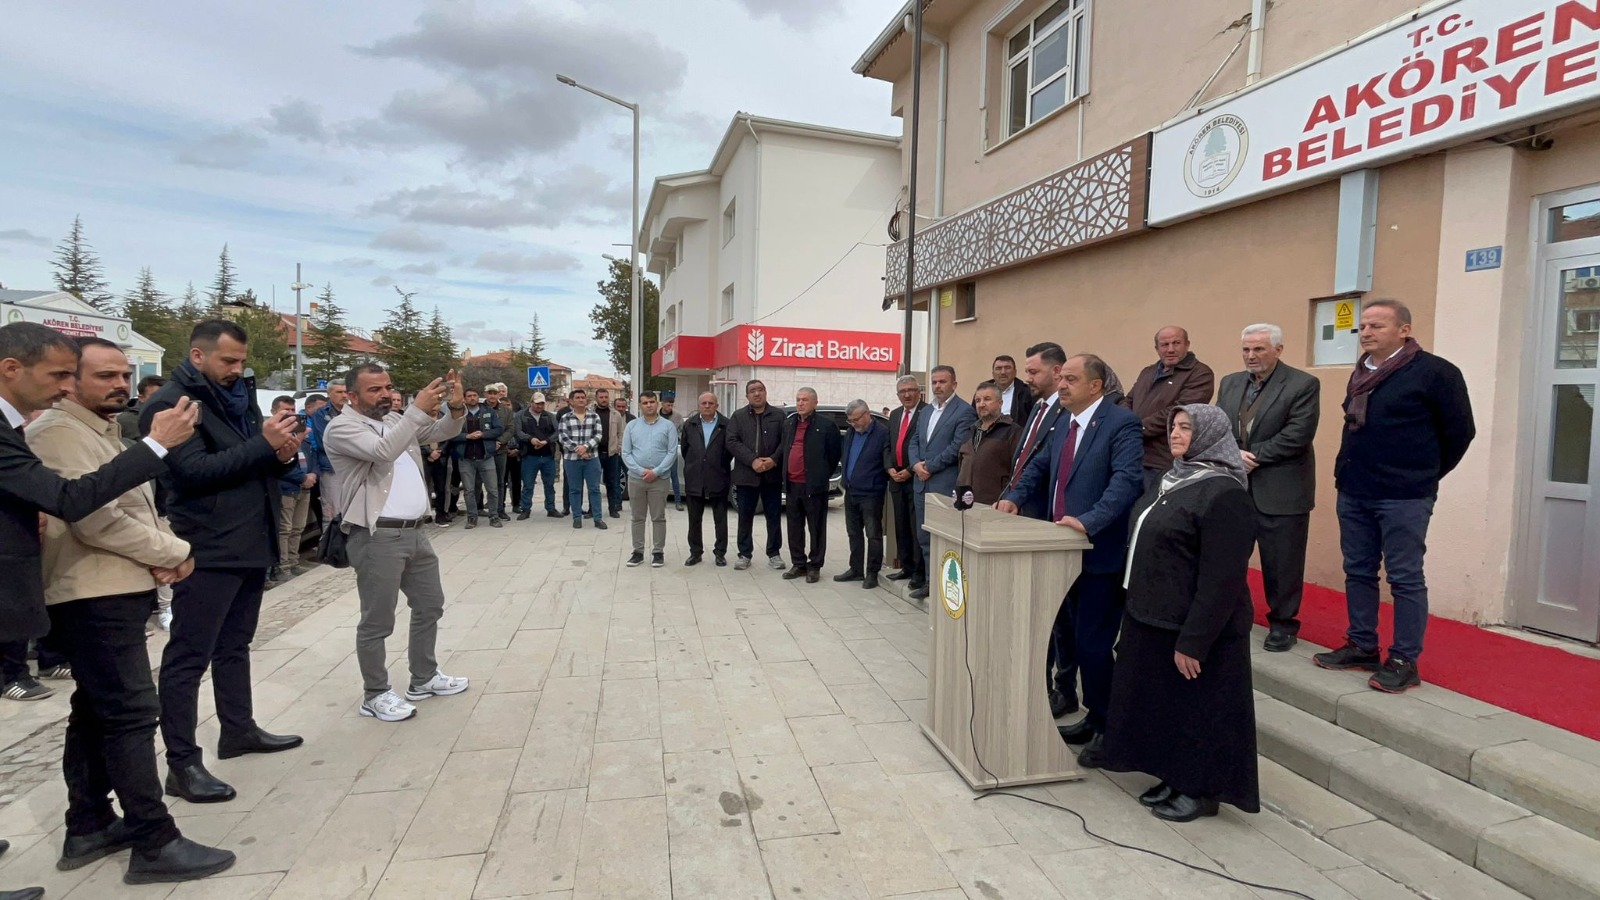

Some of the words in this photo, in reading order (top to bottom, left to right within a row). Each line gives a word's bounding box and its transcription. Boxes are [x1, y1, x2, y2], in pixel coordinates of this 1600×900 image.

[1406, 13, 1474, 48] T.C.
[1302, 0, 1600, 133] AKÖREN
[1469, 249, 1497, 267] 139
[43, 318, 70, 328] AKÖREN
[70, 322, 104, 332] BELEDİYESİ
[770, 337, 824, 359] Ziraat
[827, 340, 893, 362] Bankası
